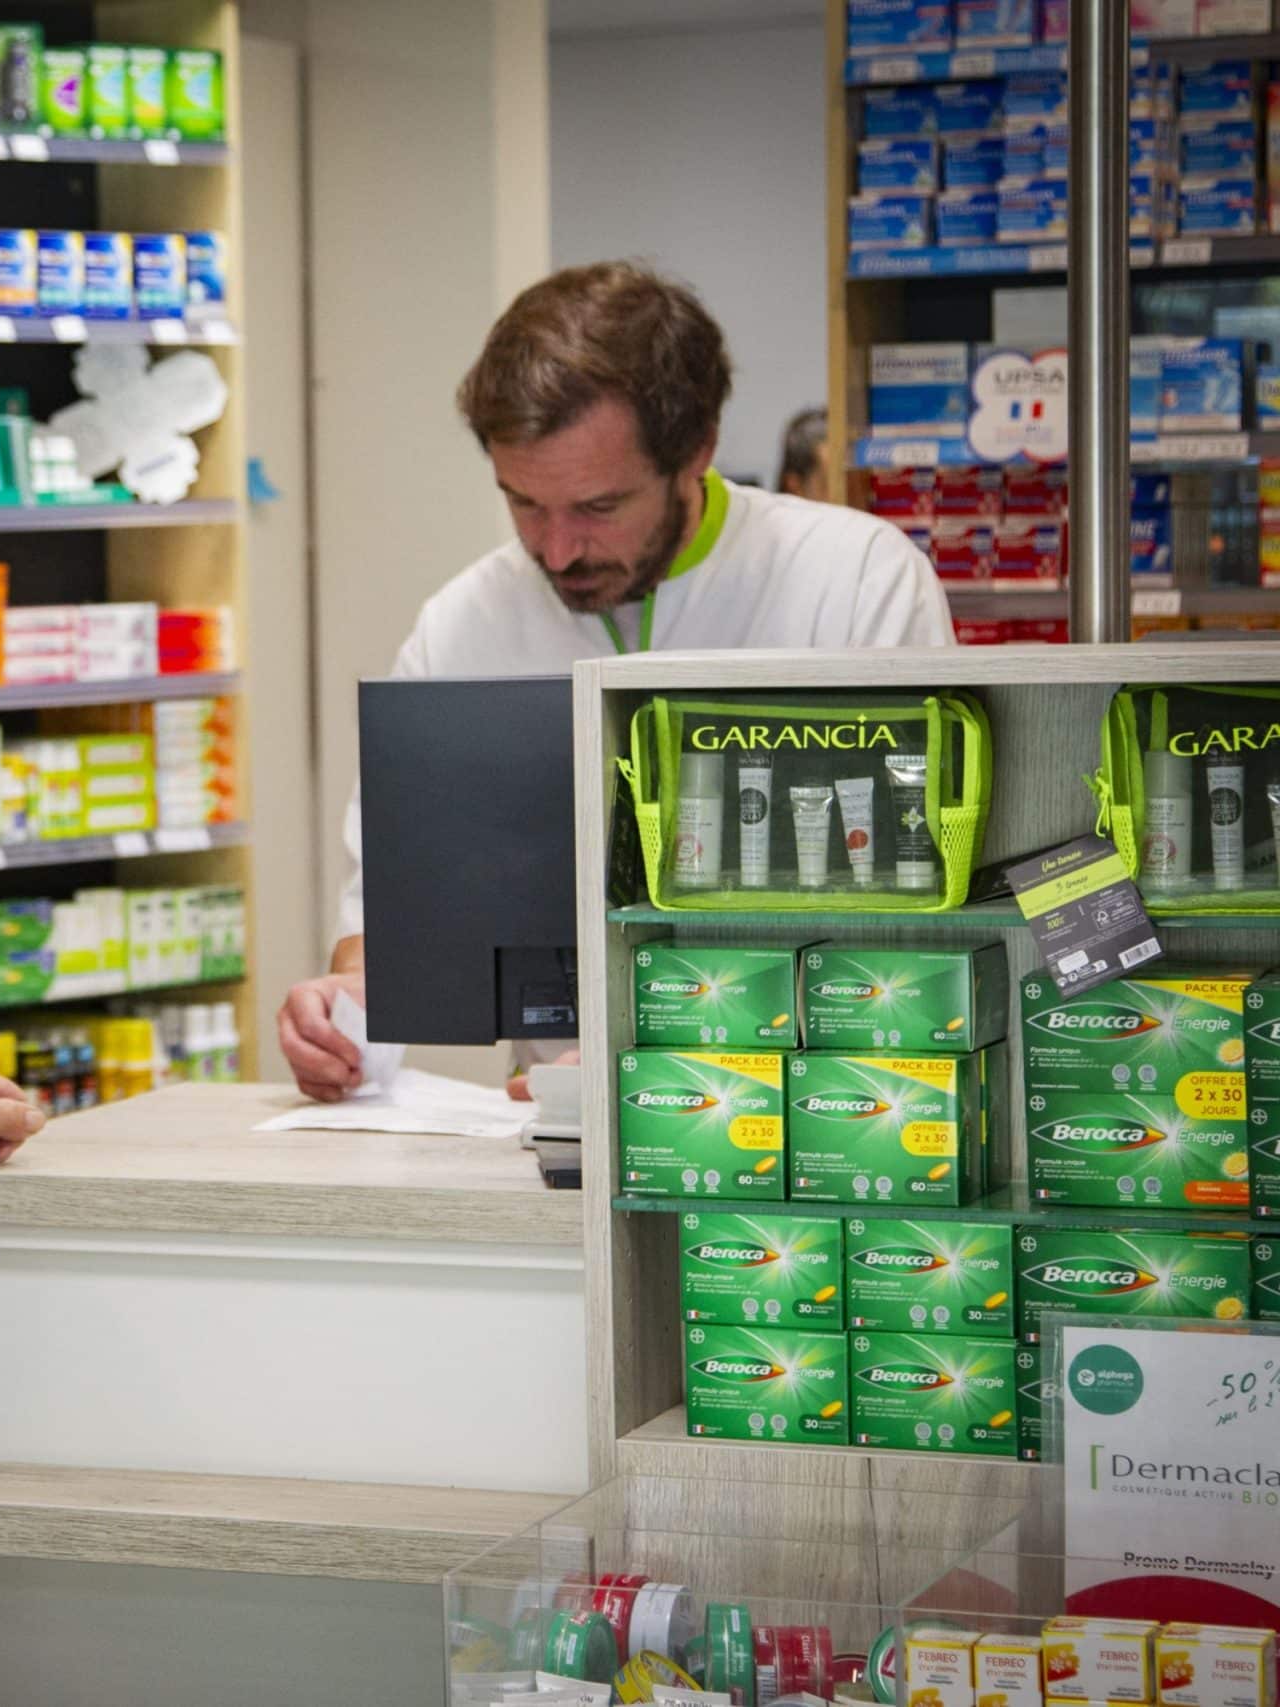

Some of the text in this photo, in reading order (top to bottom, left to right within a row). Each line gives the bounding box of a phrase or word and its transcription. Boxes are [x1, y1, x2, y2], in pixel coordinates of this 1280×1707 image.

[650, 982, 699, 992] Berocca
[821, 985, 872, 996] Berocca
[1184, 983, 1217, 993] PACK
[1047, 1012, 1140, 1029] Berocca
[720, 1056, 779, 1066] PACK ECO
[892, 1061, 953, 1071] PACK ECO
[1190, 1076, 1227, 1086] OFFRE
[637, 1092, 705, 1106] Berocca
[1194, 1088, 1243, 1101] 2 x 30
[807, 1098, 875, 1112] Berocca
[1200, 1105, 1237, 1116] JOURS
[741, 1127, 749, 1137] 2
[1052, 1124, 1145, 1142] Berocca
[914, 1134, 921, 1143] 2
[933, 1134, 948, 1143] 30
[738, 1175, 753, 1185] 60
[911, 1181, 926, 1192] 60
[699, 1246, 829, 1265] Berocca nergie
[865, 1252, 934, 1266] Berocca
[1042, 1265, 1227, 1289] Berocca Energie
[798, 1303, 812, 1314] 30
[968, 1310, 982, 1320] 30
[705, 1360, 772, 1375] Berocca
[870, 1368, 938, 1384] Berocca
[804, 1418, 818, 1429] 30
[973, 1428, 987, 1439] 30
[1111, 1454, 1280, 1487] Dermacla
[1195, 1489, 1233, 1500] ACTIVE
[1123, 1551, 1179, 1570] Promo
[918, 1651, 958, 1663] FEBREO
[1100, 1650, 1139, 1662] FEBREO
[985, 1656, 1026, 1668] FEBREO
[1215, 1659, 1255, 1672] FEBREO
